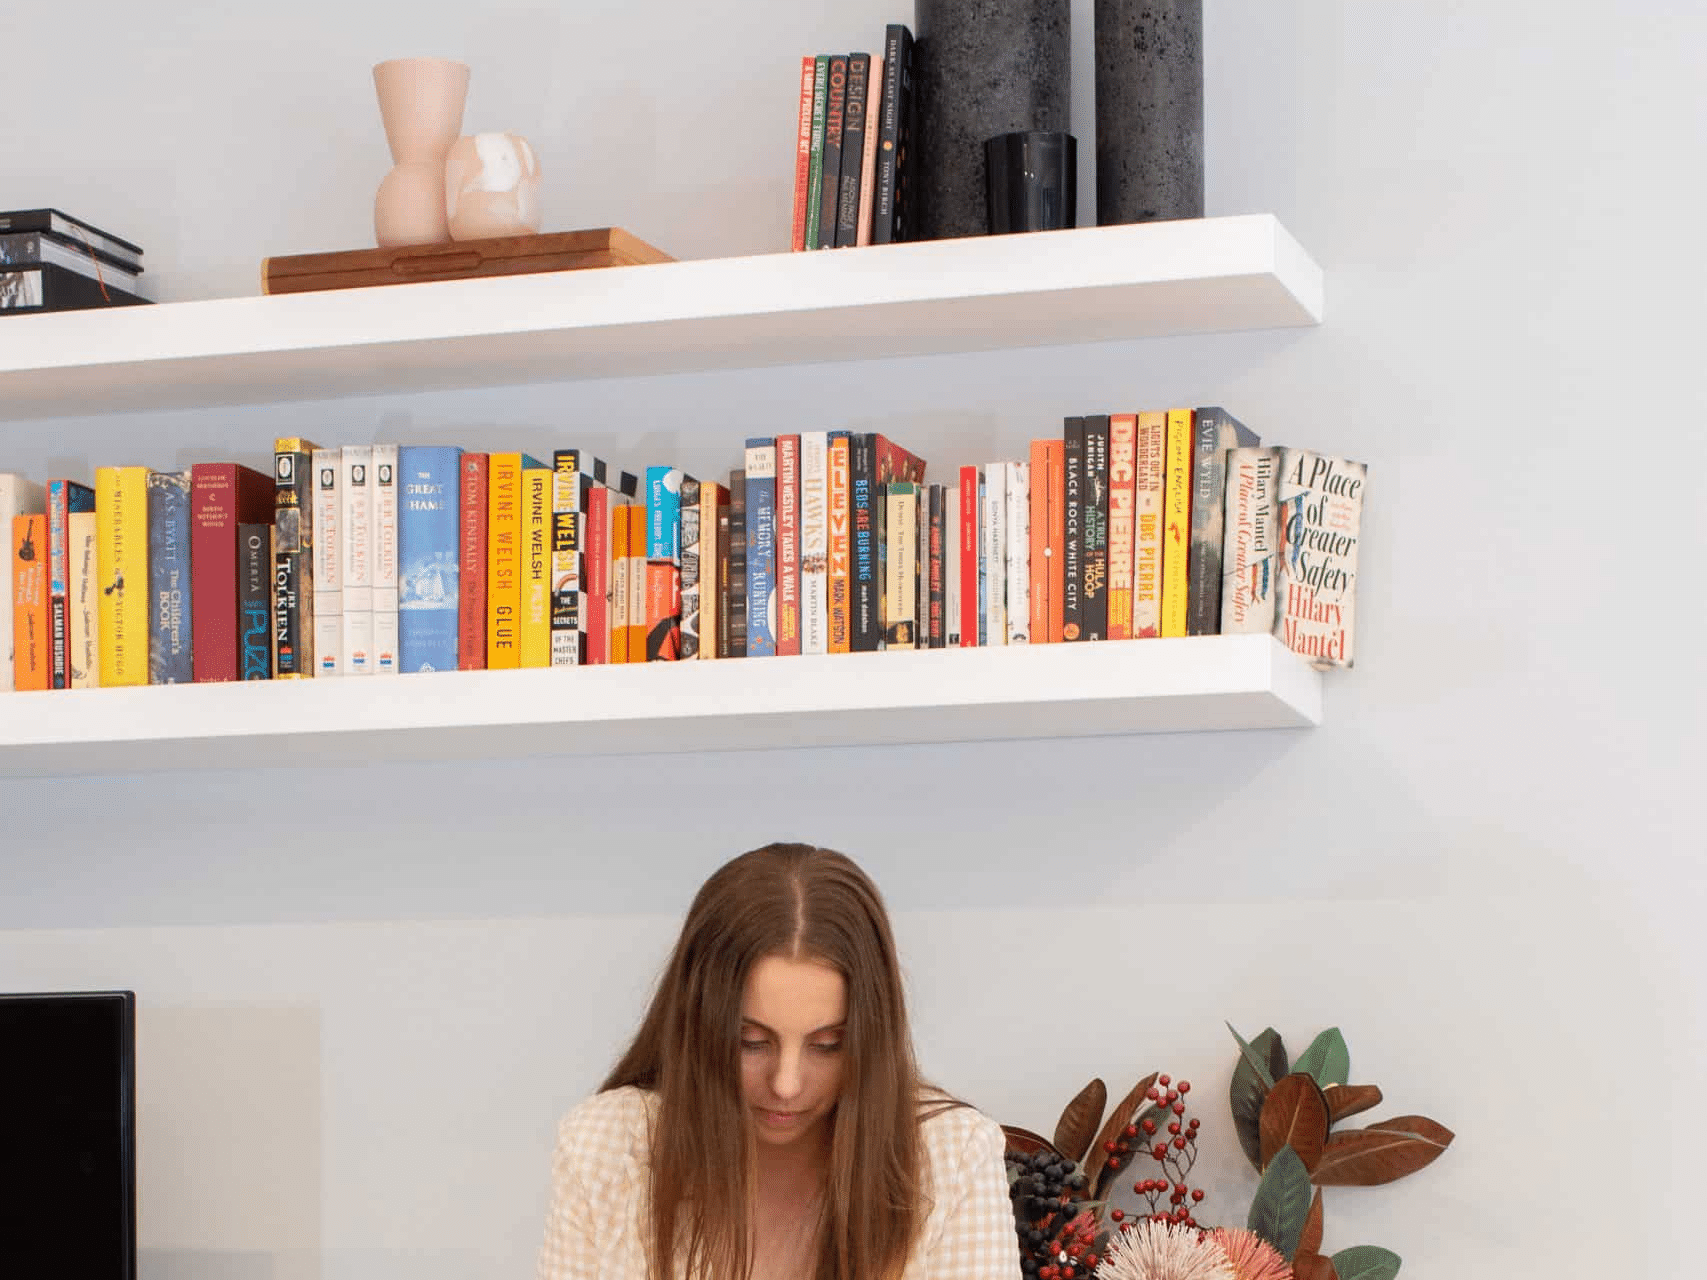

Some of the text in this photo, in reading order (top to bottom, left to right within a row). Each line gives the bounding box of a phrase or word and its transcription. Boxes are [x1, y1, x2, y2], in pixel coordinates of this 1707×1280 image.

[888, 39, 897, 63] DARK
[827, 60, 847, 149] COUNTRY
[846, 60, 864, 132] DESIGN
[887, 79, 896, 100] LAST
[885, 103, 894, 130] NIGHT
[880, 161, 891, 215] TONY BIRCH
[1096, 434, 1105, 470] JUDITH
[1110, 420, 1133, 483] DBC
[1139, 427, 1150, 491] WONDERLAND
[1149, 424, 1161, 492] LIGHTS OUT IN
[1199, 418, 1213, 499] EVIE WYLD
[1067, 457, 1078, 495] BLACK
[1172, 467, 1184, 514] ENGLISH
[1239, 474, 1254, 512] Place
[1288, 454, 1361, 500] A Place
[466, 476, 478, 573] TOM KENEALLY
[496, 464, 514, 590] IRVINE WELSH
[557, 455, 575, 571] IRVINE WELSH
[782, 440, 795, 601] MARTIN WESTLEY TAKES A WALK
[804, 477, 829, 550] HAWKS
[831, 450, 848, 576] ELEVEN
[1067, 501, 1078, 535] ROCK
[1084, 505, 1096, 550] HISTORY
[1239, 513, 1252, 527] of
[1251, 457, 1271, 552] Hilary Mantel
[1306, 495, 1328, 527] of
[165, 520, 176, 562] BYATT
[531, 478, 543, 580] IRVINE WELSH
[757, 506, 771, 557] MEMORY
[1096, 519, 1105, 546] TRUE
[1110, 487, 1133, 589] PIERRE
[1285, 512, 1356, 557] Greater
[1067, 540, 1078, 578] WHITE
[1095, 558, 1106, 589] HULA
[1138, 513, 1157, 602] DBC PIERRE
[1236, 530, 1252, 579] Greater
[1295, 551, 1354, 603] Safety
[276, 557, 292, 641] TOLKIEN
[752, 573, 767, 627] RUNNING
[860, 585, 869, 602] mark
[1067, 583, 1078, 610] CITY
[1084, 564, 1096, 599] HOOP
[1232, 584, 1250, 625] Safety
[1286, 583, 1345, 626] Hilary
[159, 591, 170, 630] BOOK
[169, 570, 182, 654] The Children's
[496, 606, 513, 650] GLUE
[809, 580, 818, 647] MARTIN BLAKE
[833, 578, 846, 644] MARK WATSON
[54, 603, 63, 675] SALMAN RUSHDIE
[114, 646, 124, 677] HUGO
[1284, 617, 1345, 661] Mantel
